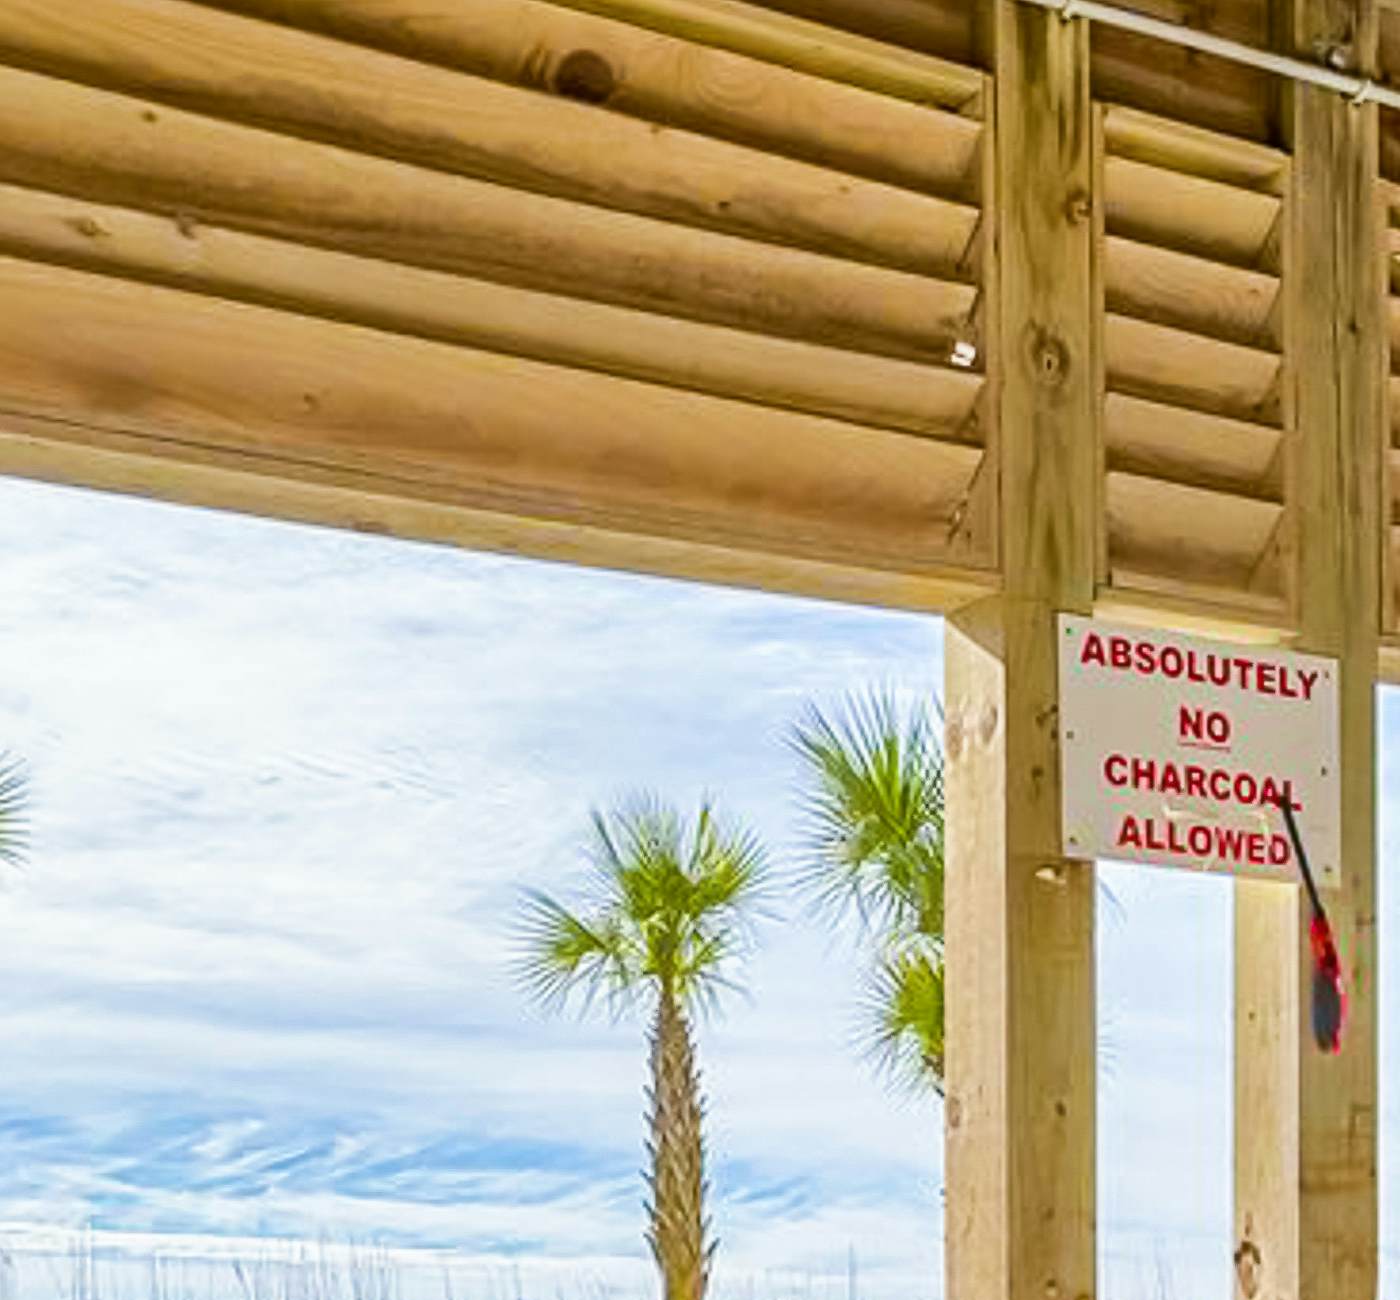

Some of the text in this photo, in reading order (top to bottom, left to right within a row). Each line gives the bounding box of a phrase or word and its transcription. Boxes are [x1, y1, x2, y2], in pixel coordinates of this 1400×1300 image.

[1081, 632, 1318, 699] ABSOLUTELY
[1179, 705, 1231, 744] NO
[1104, 754, 1302, 811] CHARCOAL
[1117, 815, 1291, 865] ALLOWED
